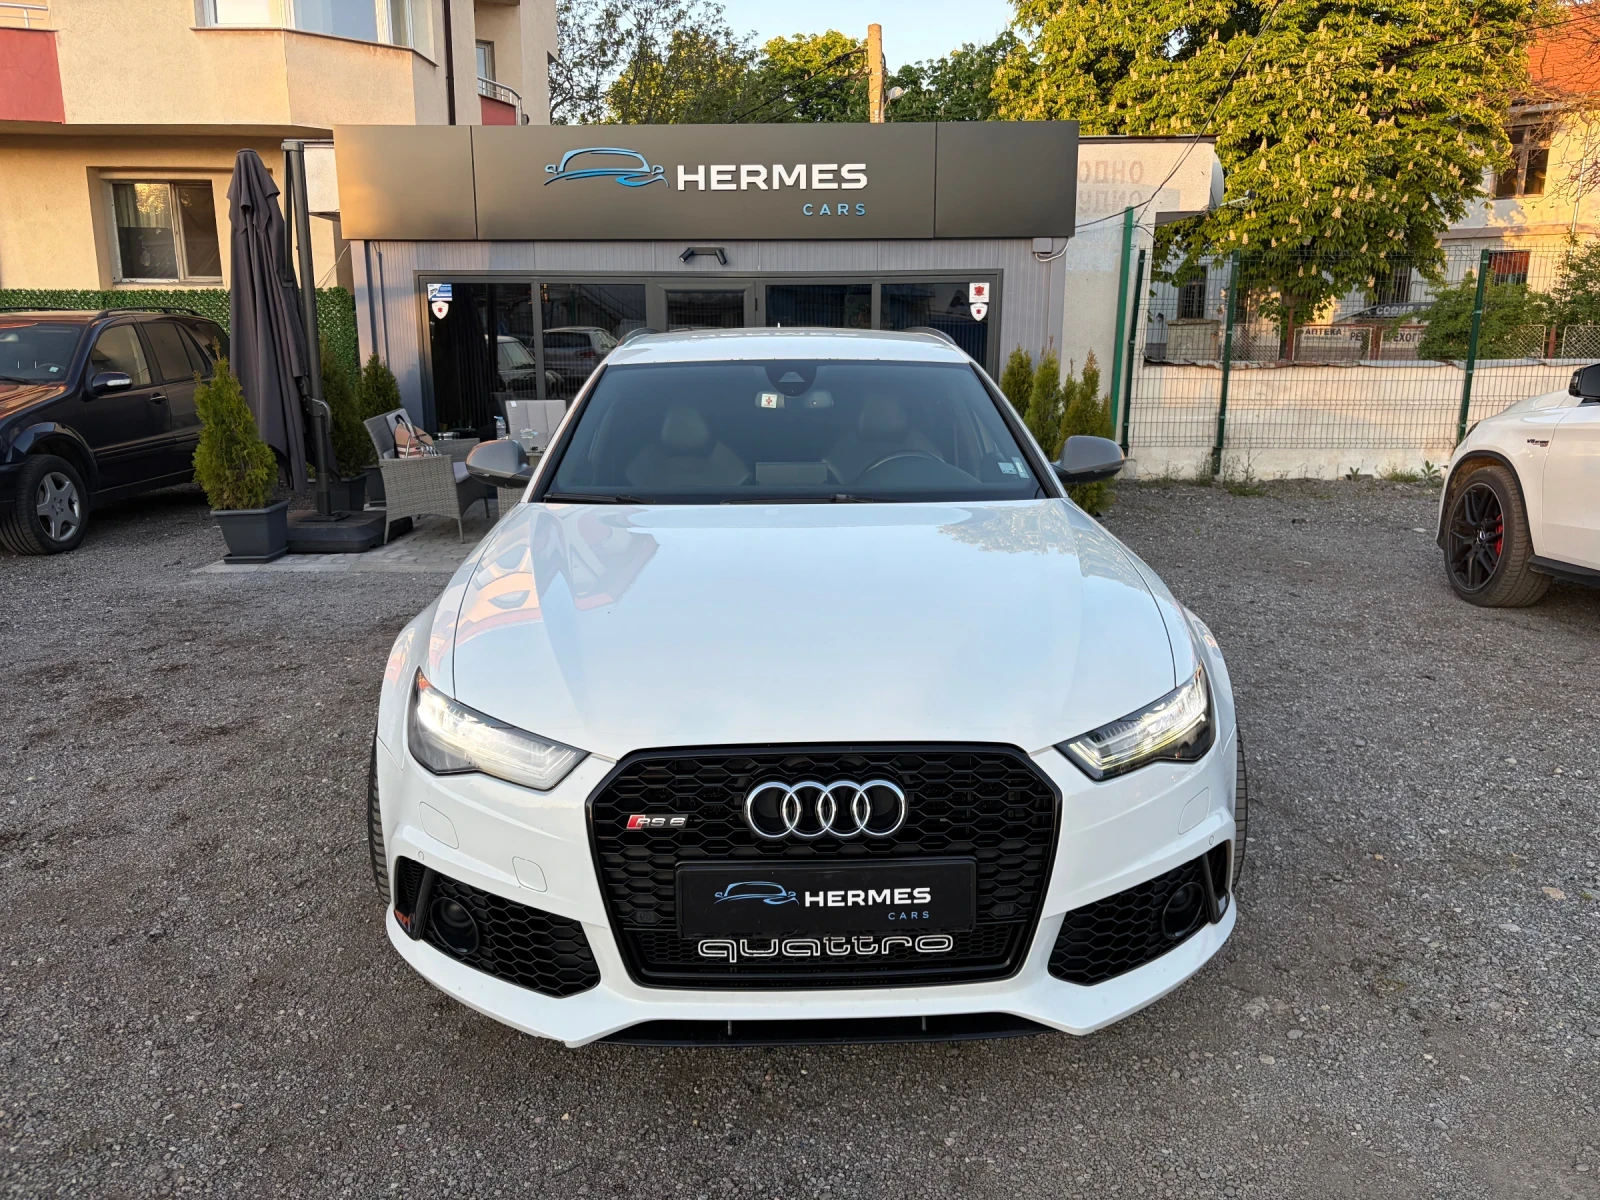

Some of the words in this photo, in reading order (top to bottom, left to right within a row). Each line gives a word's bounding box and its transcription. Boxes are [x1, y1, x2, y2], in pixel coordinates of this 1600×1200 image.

[677, 163, 868, 191] HERMES
[802, 203, 867, 217] CARS
[1376, 305, 1414, 315] СОФИЯ
[1304, 327, 1342, 336] АПТЕКА
[804, 887, 932, 907] HERMES
[887, 910, 930, 920] CARS
[698, 934, 954, 963] quattro
